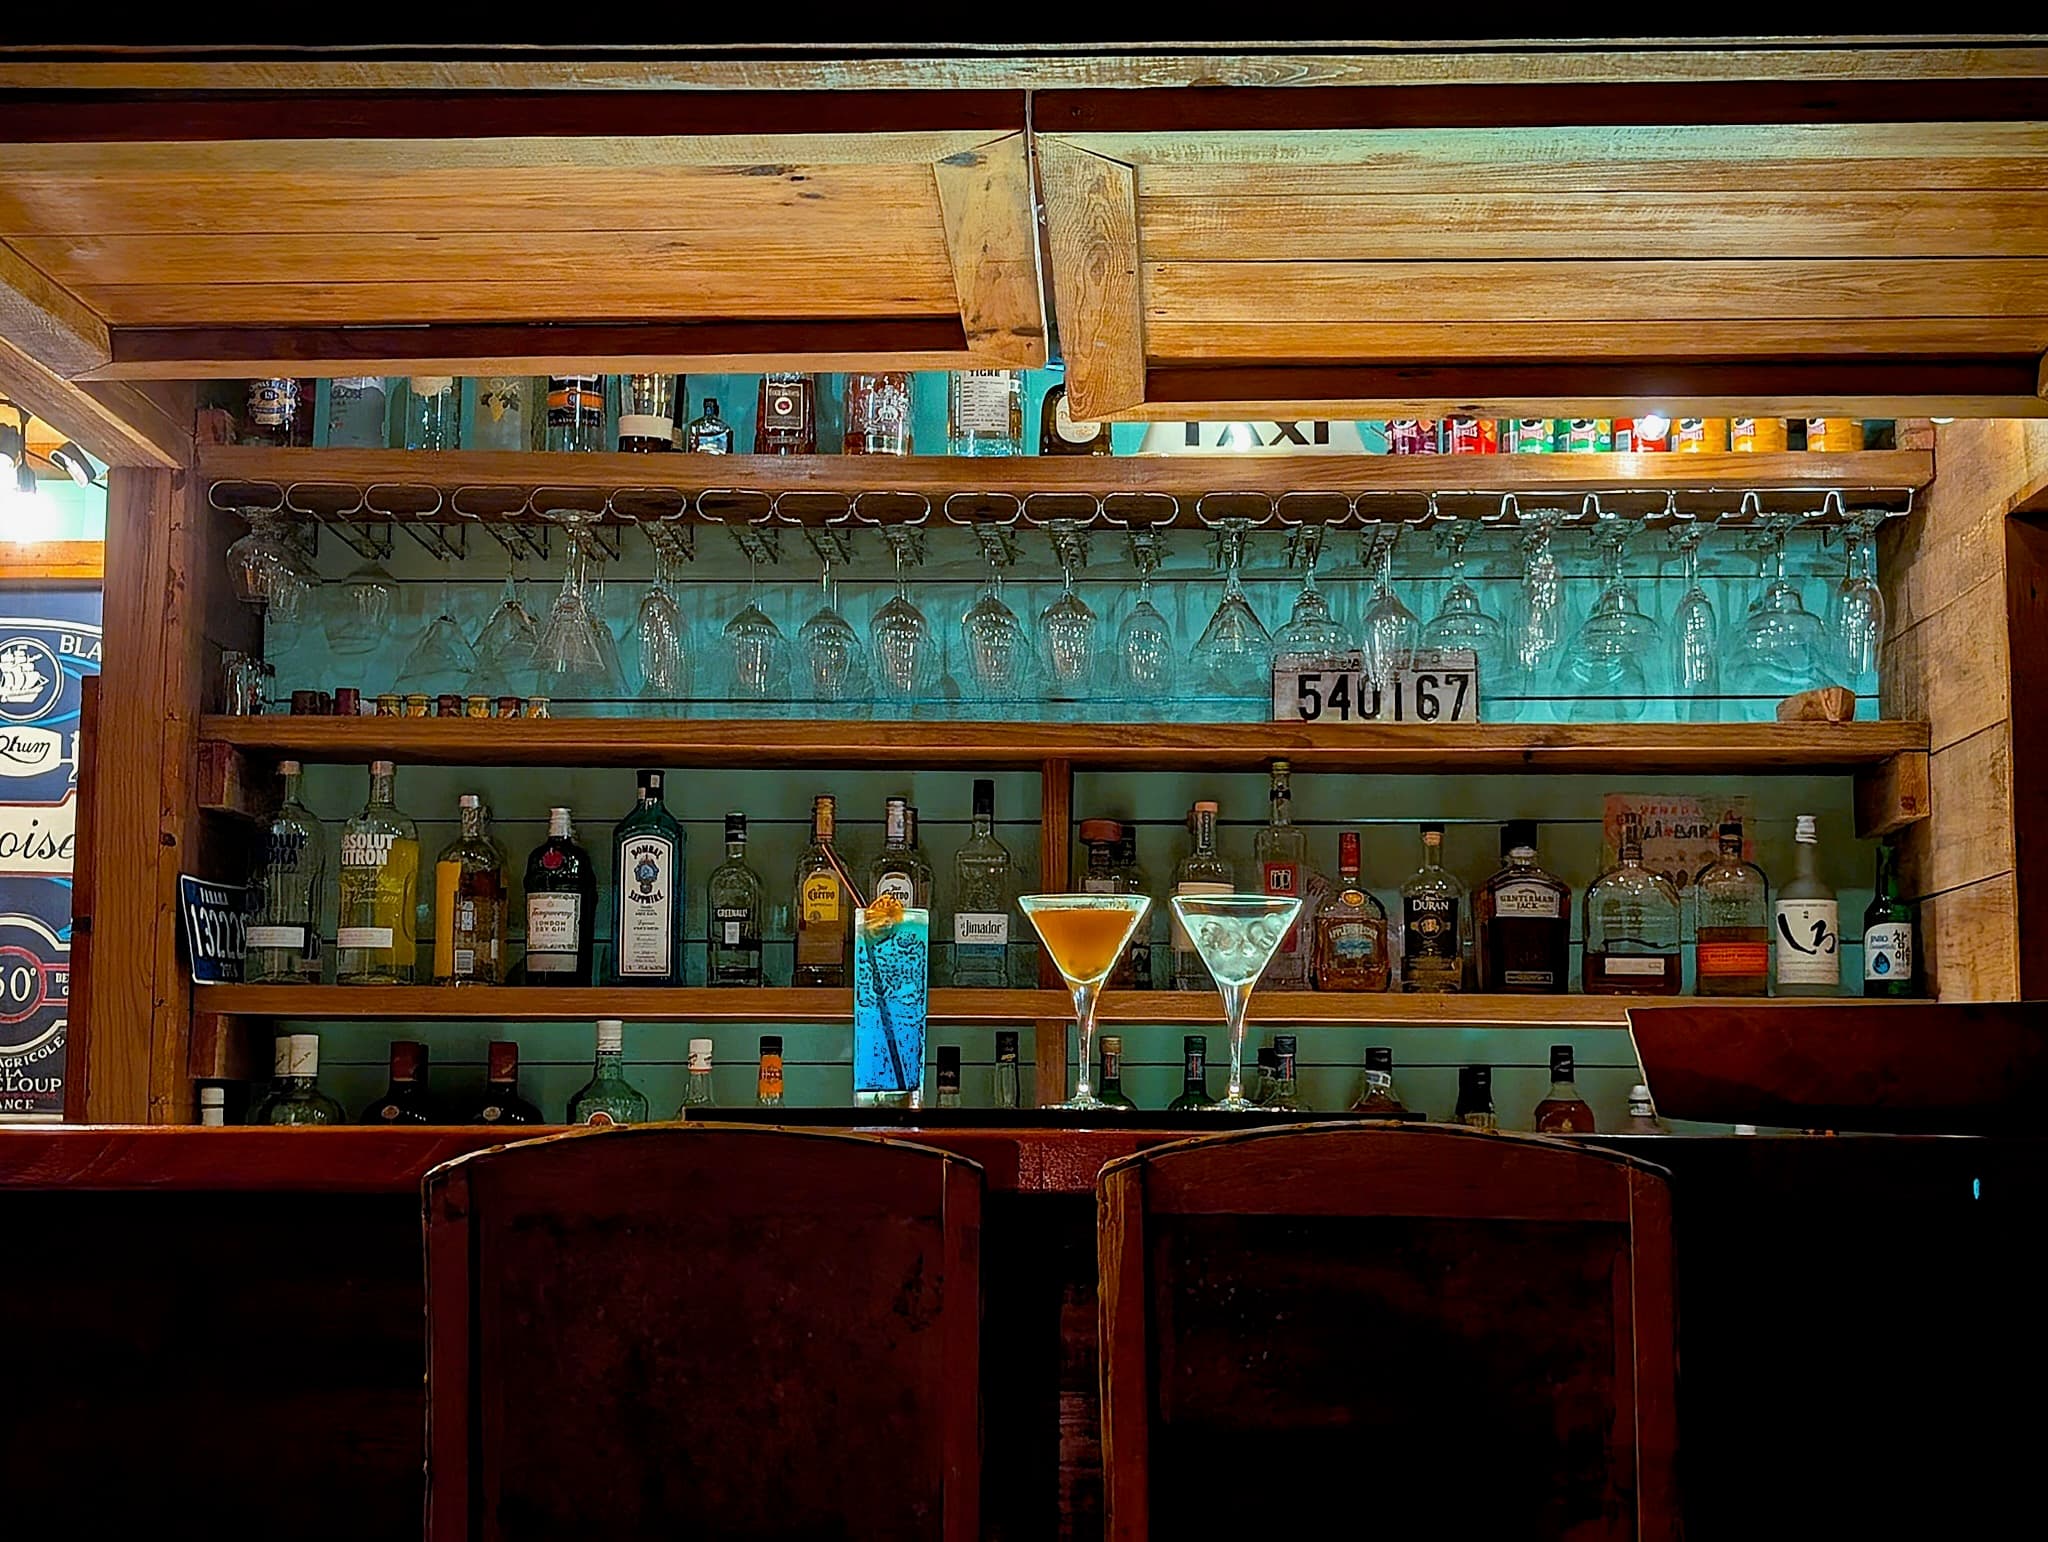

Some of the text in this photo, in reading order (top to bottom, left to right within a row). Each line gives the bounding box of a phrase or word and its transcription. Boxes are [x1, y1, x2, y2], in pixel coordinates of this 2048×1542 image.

[59, 634, 102, 662] BLA
[0, 819, 75, 859] oise
[961, 919, 1002, 937] Jimador
